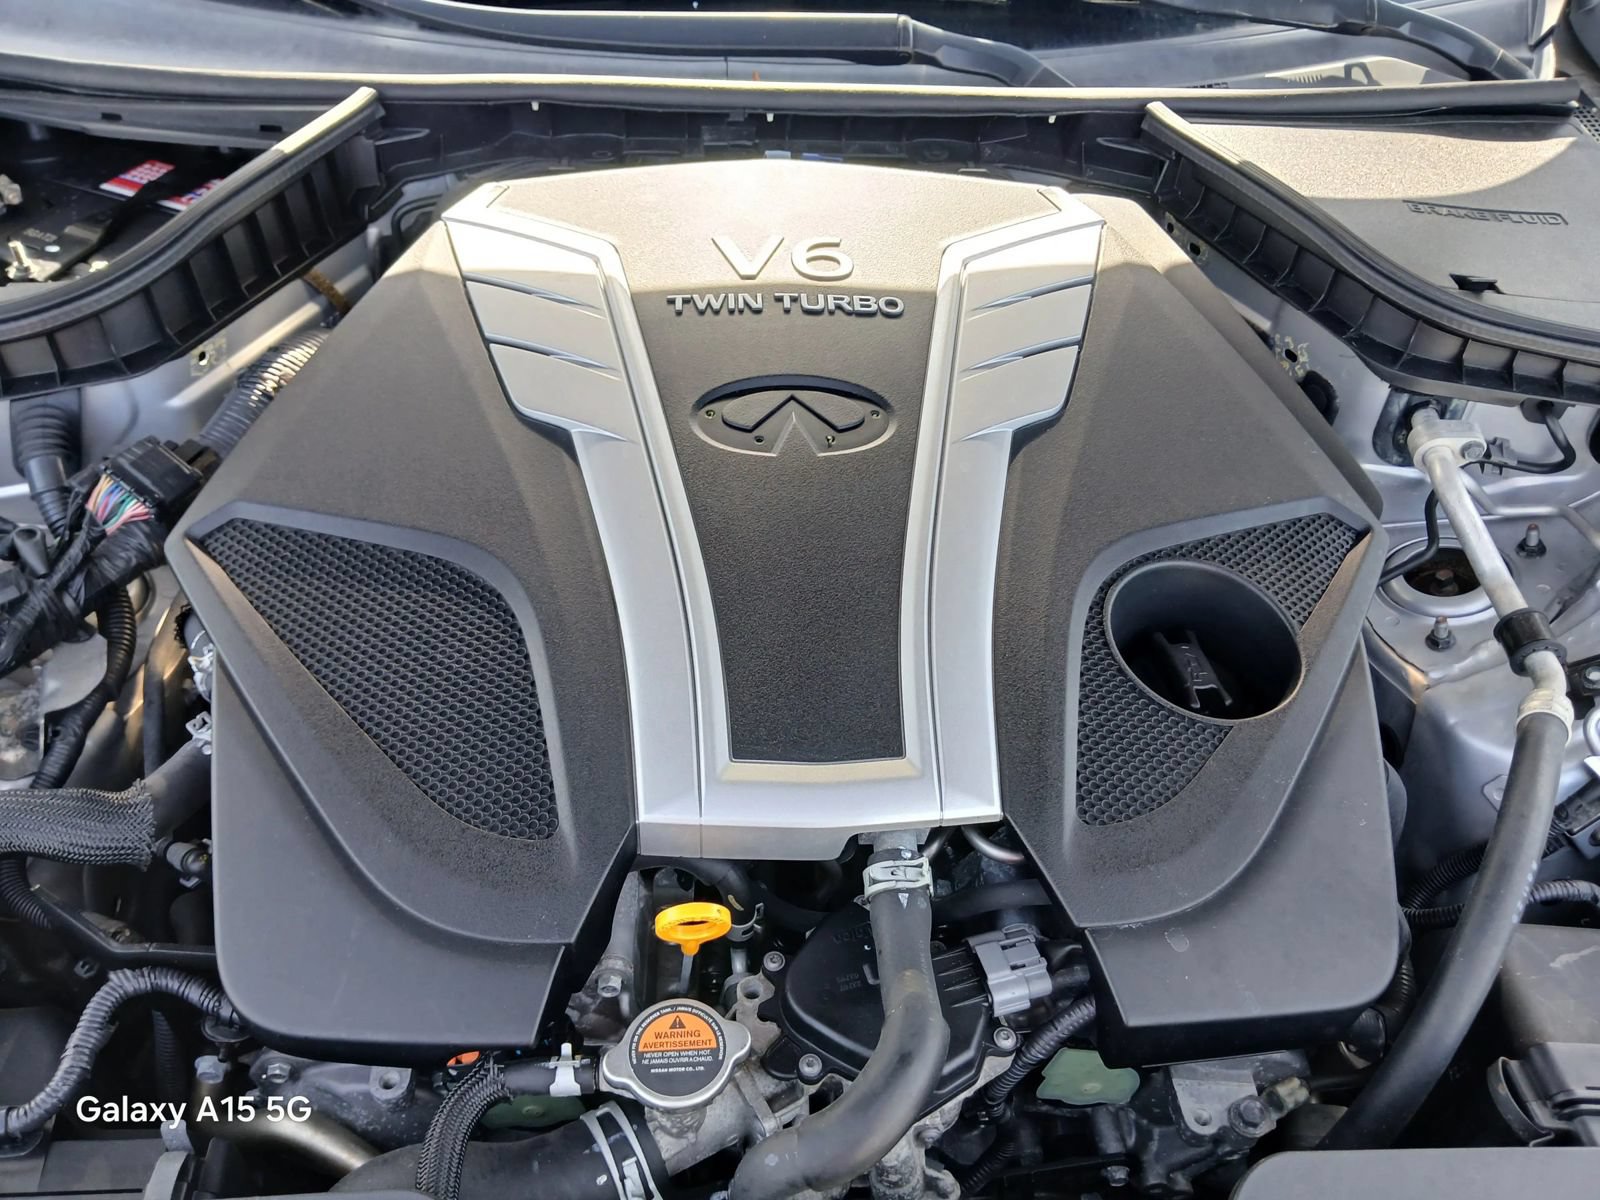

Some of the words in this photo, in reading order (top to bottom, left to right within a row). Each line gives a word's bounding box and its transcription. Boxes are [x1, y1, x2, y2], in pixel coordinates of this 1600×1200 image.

[1406, 202, 1491, 222] BRAKE
[1494, 210, 1562, 225] FLUID
[711, 235, 854, 281] V6
[666, 293, 764, 315] TWIN
[774, 293, 905, 317] TURBO
[642, 1039, 712, 1049] AVERTISSEMENT
[654, 1030, 701, 1039] WARNING
